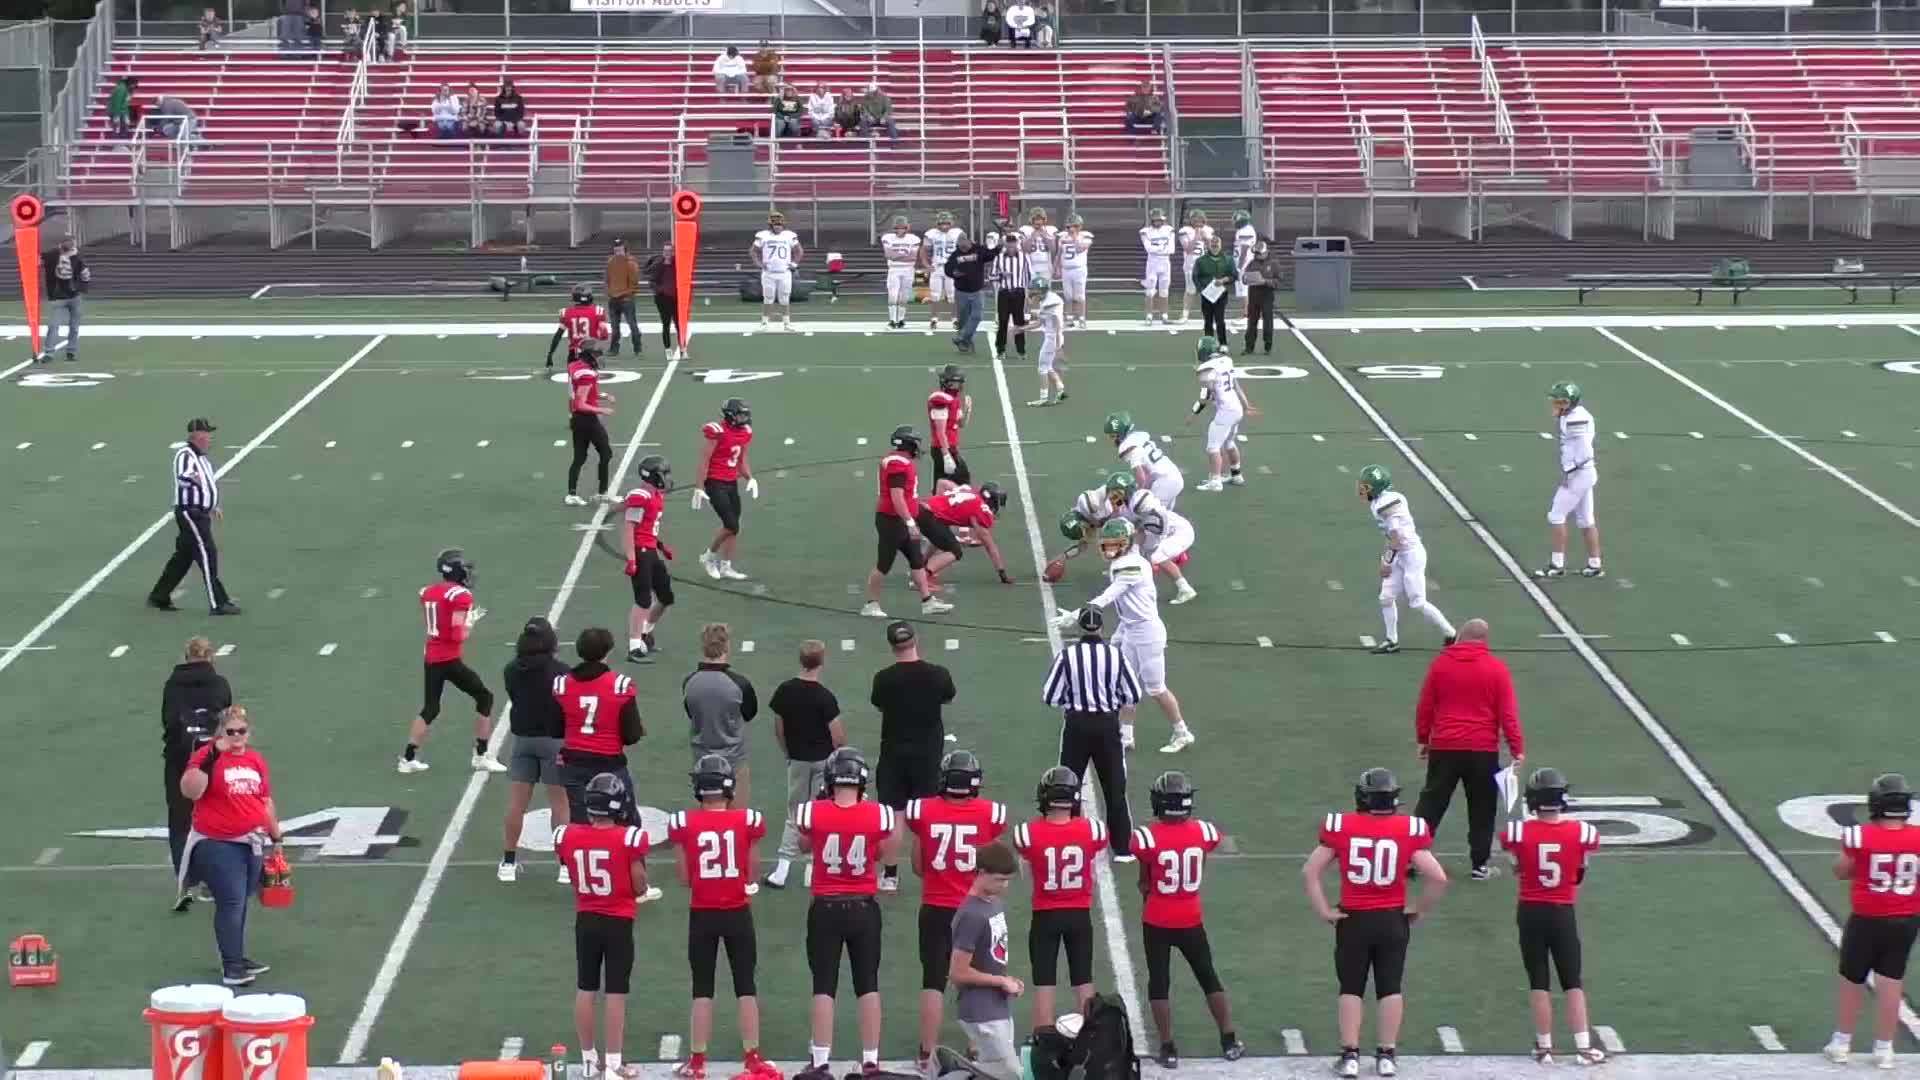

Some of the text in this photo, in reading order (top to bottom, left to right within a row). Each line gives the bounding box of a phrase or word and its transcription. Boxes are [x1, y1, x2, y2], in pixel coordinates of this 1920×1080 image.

[766, 245, 788, 260] 70
[569, 317, 591, 339] 13
[727, 445, 742, 468] 3
[424, 601, 440, 637] 11
[579, 696, 599, 734] 7
[697, 830, 740, 879] 21
[822, 833, 867, 876] 44
[930, 824, 978, 873] 75
[1043, 845, 1084, 891] 12
[1346, 837, 1399, 886] 50
[1537, 843, 1562, 888] 5
[573, 850, 613, 896] 15
[1157, 847, 1204, 894] 30
[1868, 853, 1920, 895] 58
[174, 1029, 200, 1058] G
[246, 1038, 273, 1066] G
